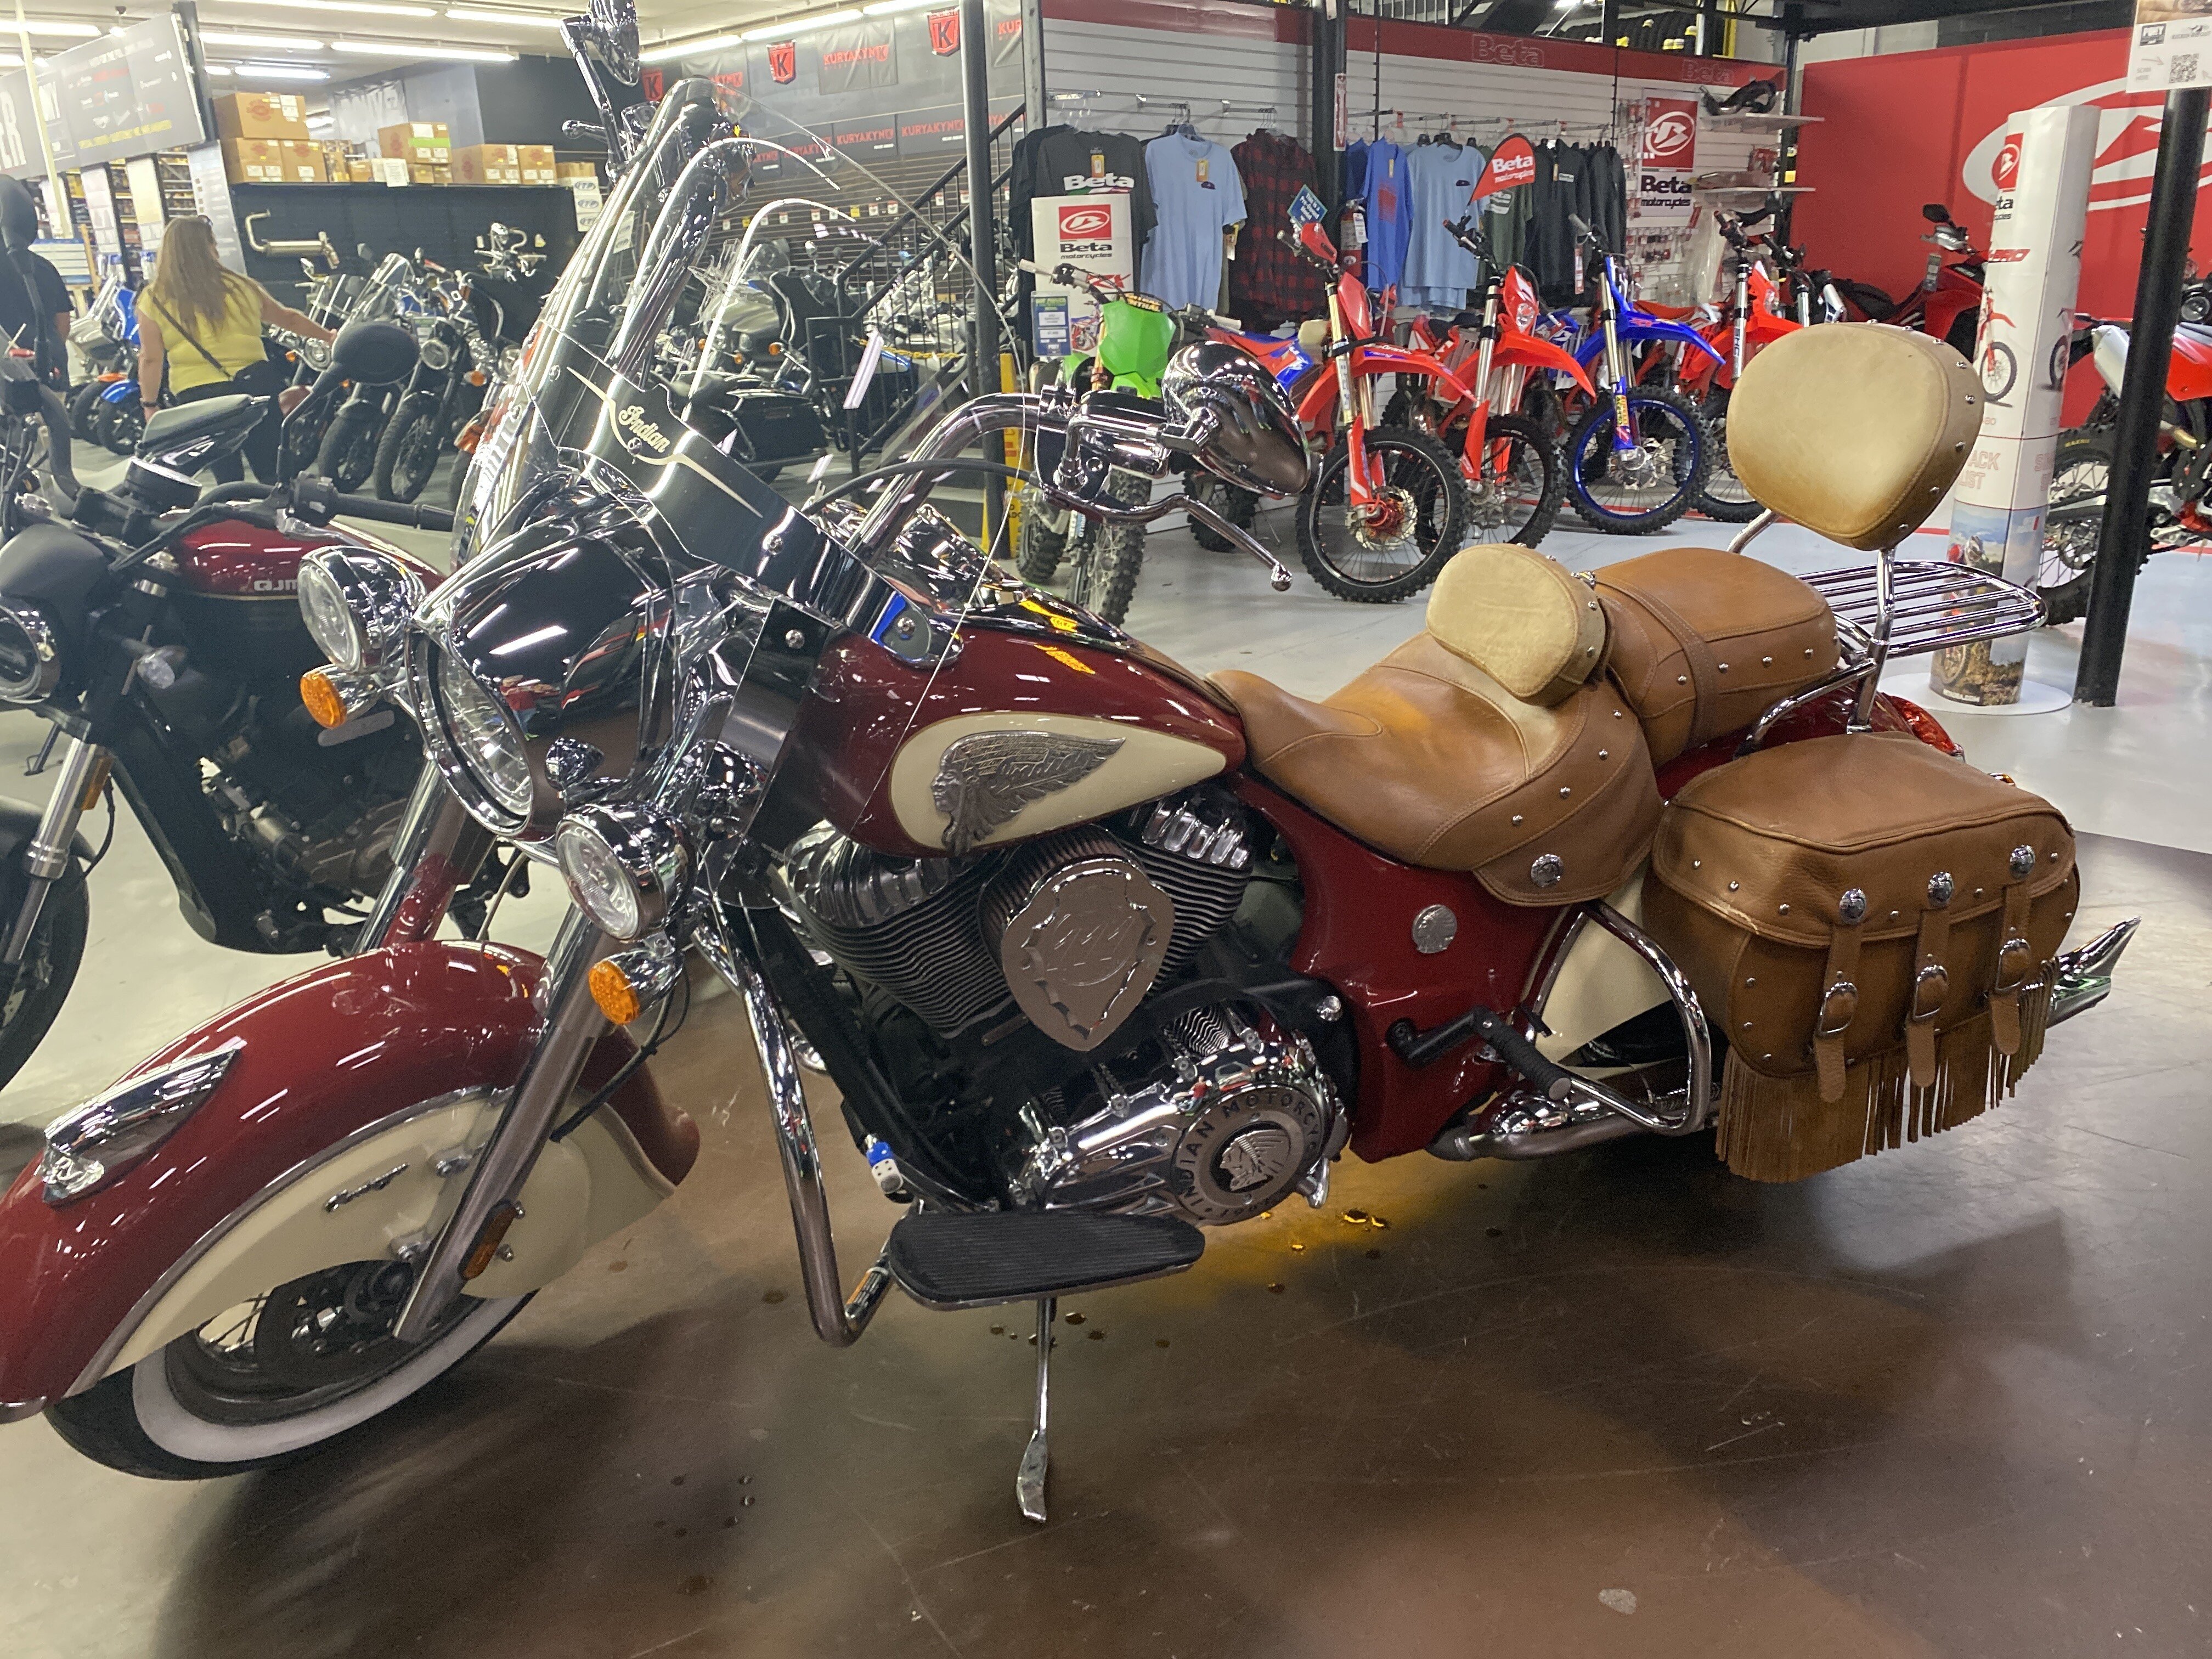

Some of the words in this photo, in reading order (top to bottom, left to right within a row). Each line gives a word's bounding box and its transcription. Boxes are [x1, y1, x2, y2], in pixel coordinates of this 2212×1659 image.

[1472, 34, 1544, 67] Beta
[1492, 155, 1533, 174] Beta
[1064, 173, 1135, 190] Beta
[1641, 175, 1692, 194] Beta
[1641, 197, 1691, 209] motorcycles
[1060, 242, 1112, 252] Beta
[618, 405, 670, 453] Indian
[1180, 1121, 1216, 1206] INDIAN
